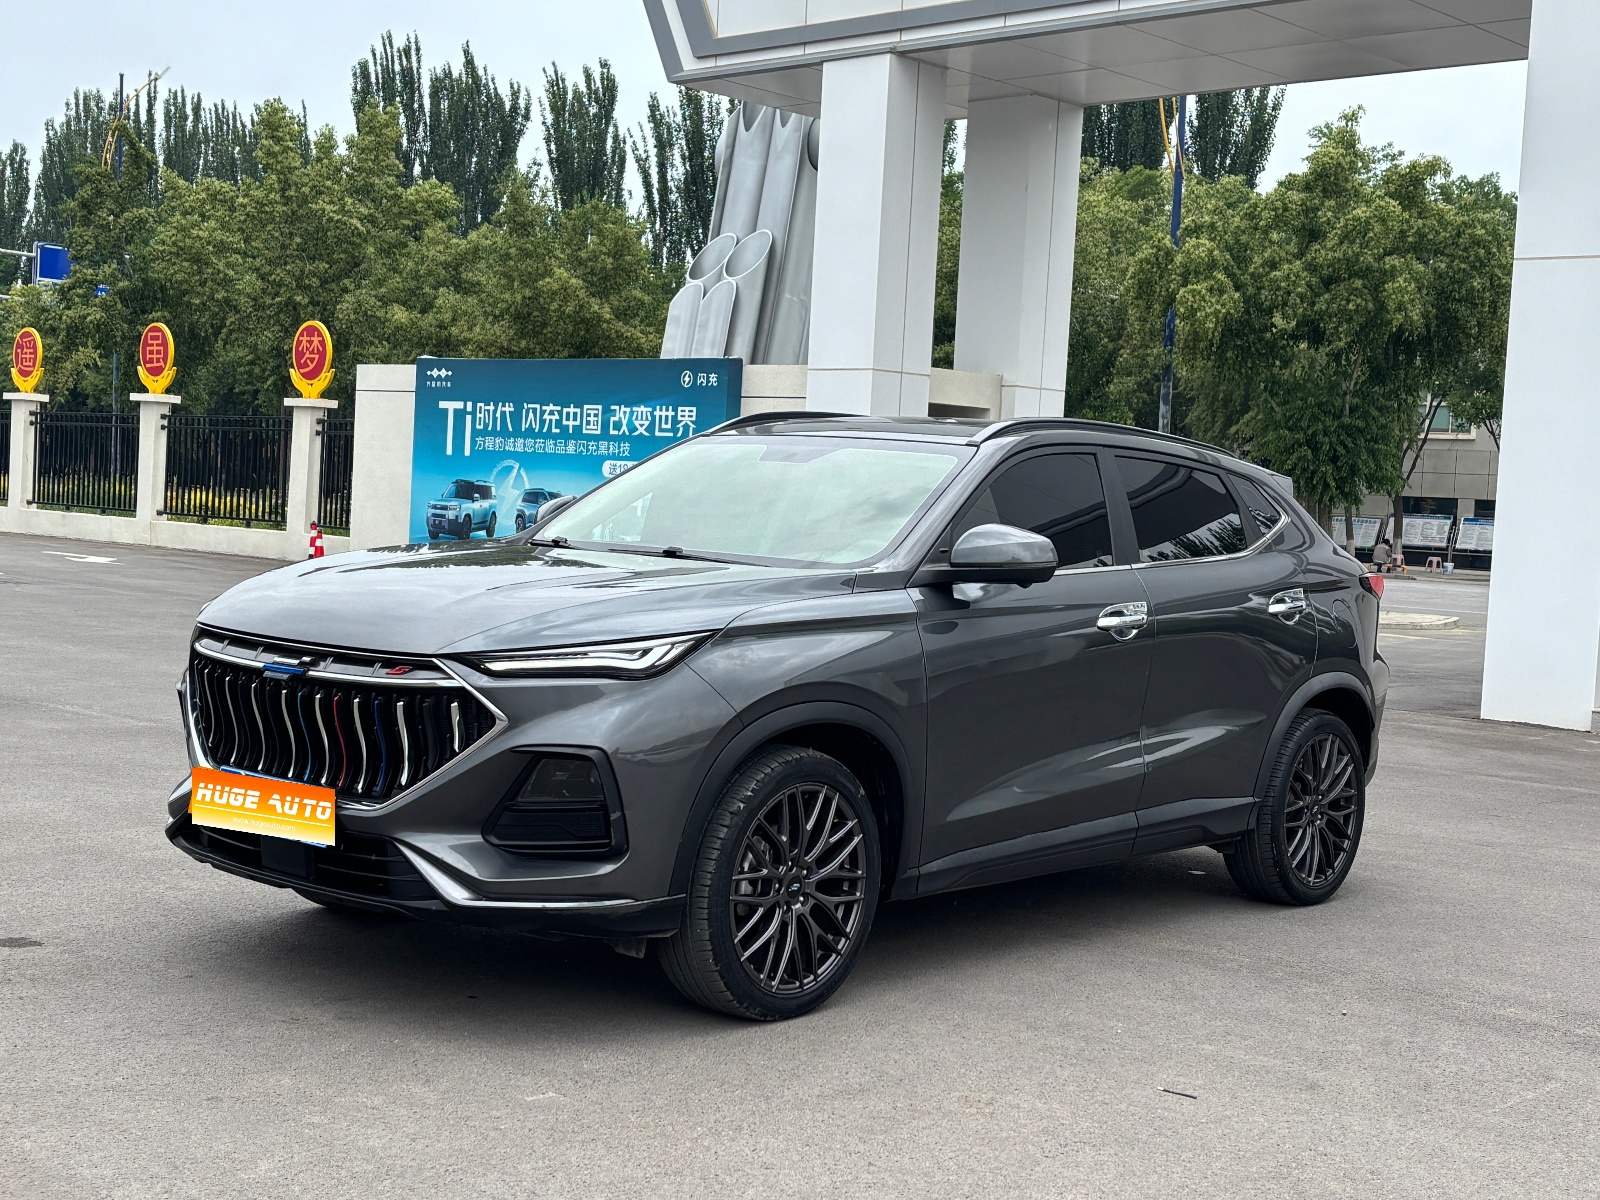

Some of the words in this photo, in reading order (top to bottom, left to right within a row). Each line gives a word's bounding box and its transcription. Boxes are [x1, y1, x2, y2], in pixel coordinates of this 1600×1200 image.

[16, 336, 35, 371] 遥
[145, 332, 165, 368] 虽
[299, 331, 322, 373] 梦
[697, 373, 718, 387] 闪充
[522, 403, 602, 434] 闪充中国
[609, 405, 697, 437] 改变世界
[475, 437, 630, 457] 方程豹诚邀您莅临品鉴闪充黑科技
